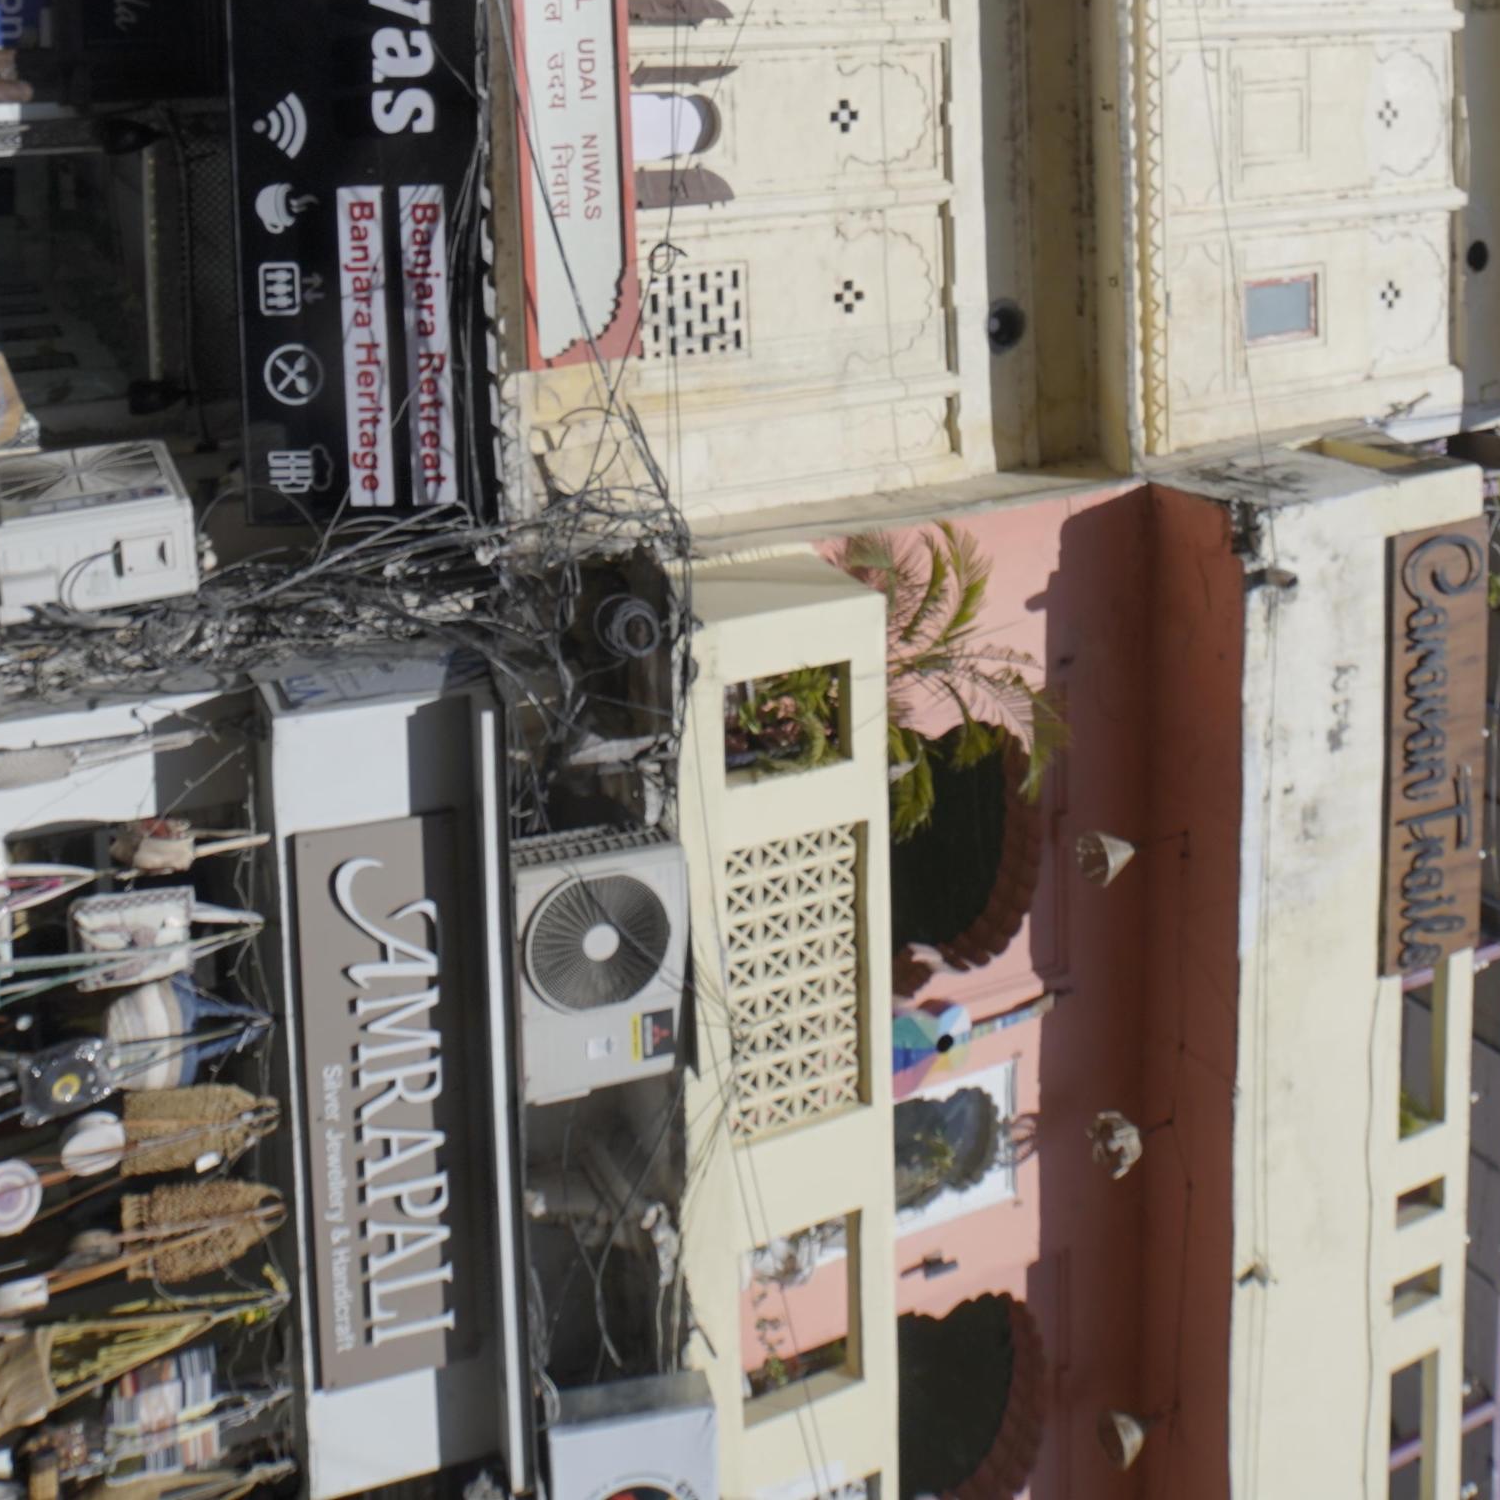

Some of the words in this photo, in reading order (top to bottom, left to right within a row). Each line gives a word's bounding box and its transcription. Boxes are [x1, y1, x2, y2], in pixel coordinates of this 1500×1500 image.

[547, 52, 567, 110] उदय
[577, 38, 597, 101] UDAI
[549, 143, 575, 220] निवास
[581, 134, 602, 221] NIWAS
[343, 201, 377, 328] Banjara
[405, 202, 441, 338] Banjara
[352, 342, 384, 492] Heritage
[417, 353, 447, 488] Retreat
[1401, 534, 1484, 801] Caravan
[1394, 765, 1472, 971] Trails
[321, 1063, 344, 1122] Silver
[333, 858, 455, 1348] AMRAPALI
[323, 1128, 347, 1222] Jewellery
[330, 1226, 351, 1244] &
[331, 1247, 356, 1353] Handicraft
